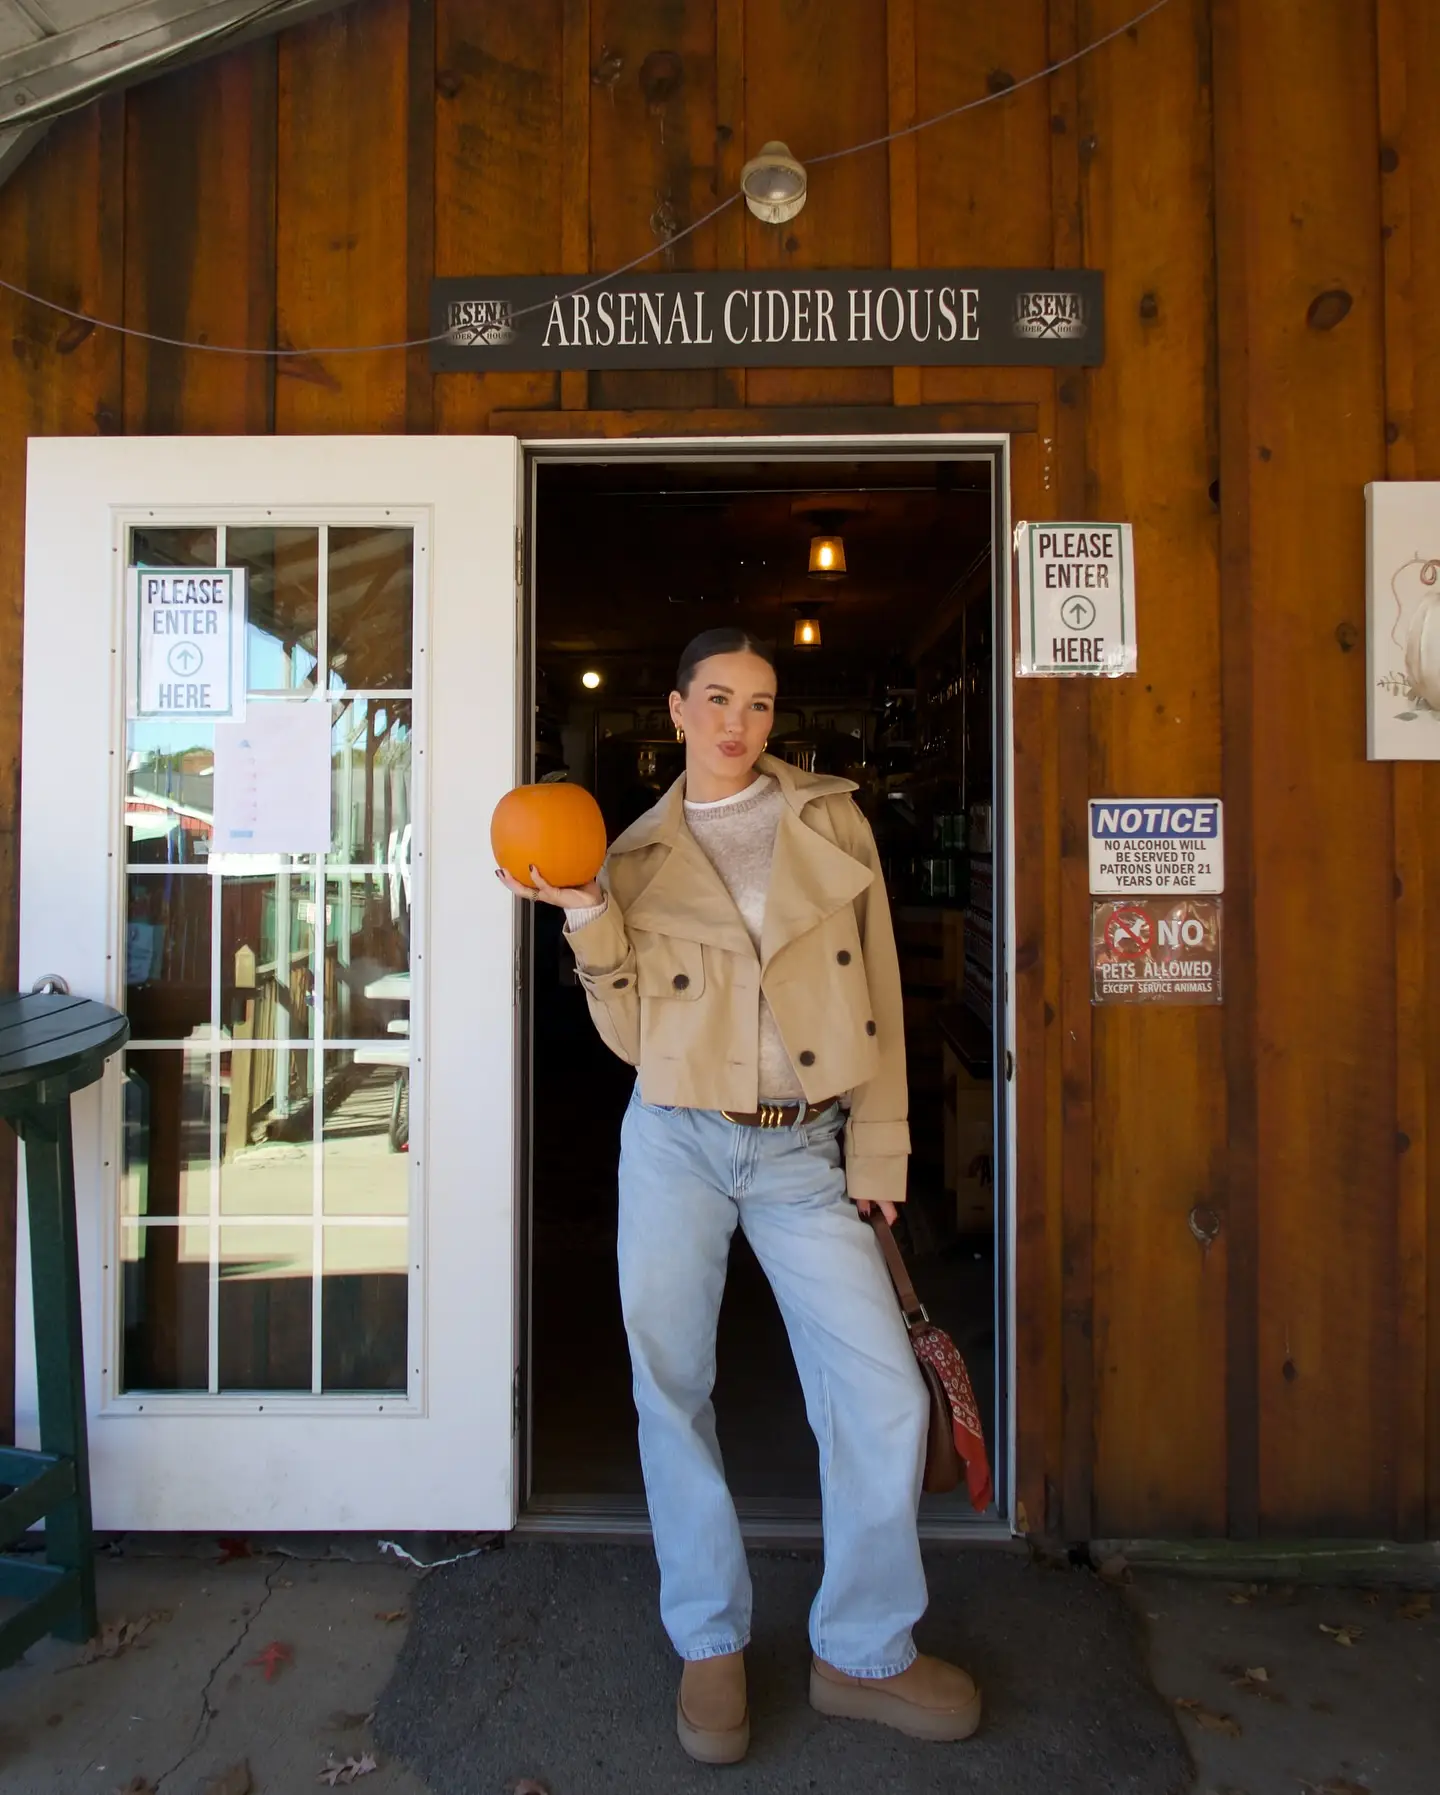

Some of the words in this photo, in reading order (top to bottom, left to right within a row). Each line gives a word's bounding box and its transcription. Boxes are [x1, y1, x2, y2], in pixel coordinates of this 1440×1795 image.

[446, 301, 514, 332] RSENA
[541, 291, 713, 347] ARSENAL
[723, 289, 838, 345] CIDER
[847, 287, 980, 342] HOUSE
[1014, 294, 1084, 321] RSENA
[1039, 533, 1114, 559] PLEASE
[1045, 563, 1109, 589] ENTER
[147, 579, 224, 604] PLEASE
[152, 609, 218, 635] ENTER
[1052, 637, 1104, 663] HERE
[158, 683, 211, 709] HERE
[1097, 808, 1214, 833] NOTICE
[1104, 840, 1121, 851] NO
[1123, 840, 1177, 851] ALCOHOL
[1179, 840, 1206, 851] WILL
[1116, 852, 1132, 863] BE
[1134, 851, 1178, 863] SERVED
[1181, 852, 1195, 862] TO
[1100, 864, 1152, 875] PATRONS
[1155, 864, 1195, 875] UNDER
[1198, 864, 1212, 875] 21
[1116, 875, 1153, 887] YEARS
[1156, 875, 1171, 887] OF
[1173, 875, 1196, 887] AGE
[1157, 919, 1204, 947] NO
[1102, 962, 1136, 979] PETS
[1144, 961, 1212, 978] ALLOWED
[1103, 983, 1134, 994] EXCEPT
[1138, 982, 1172, 994] SERVICE
[1174, 982, 1212, 993] ANIMALS
